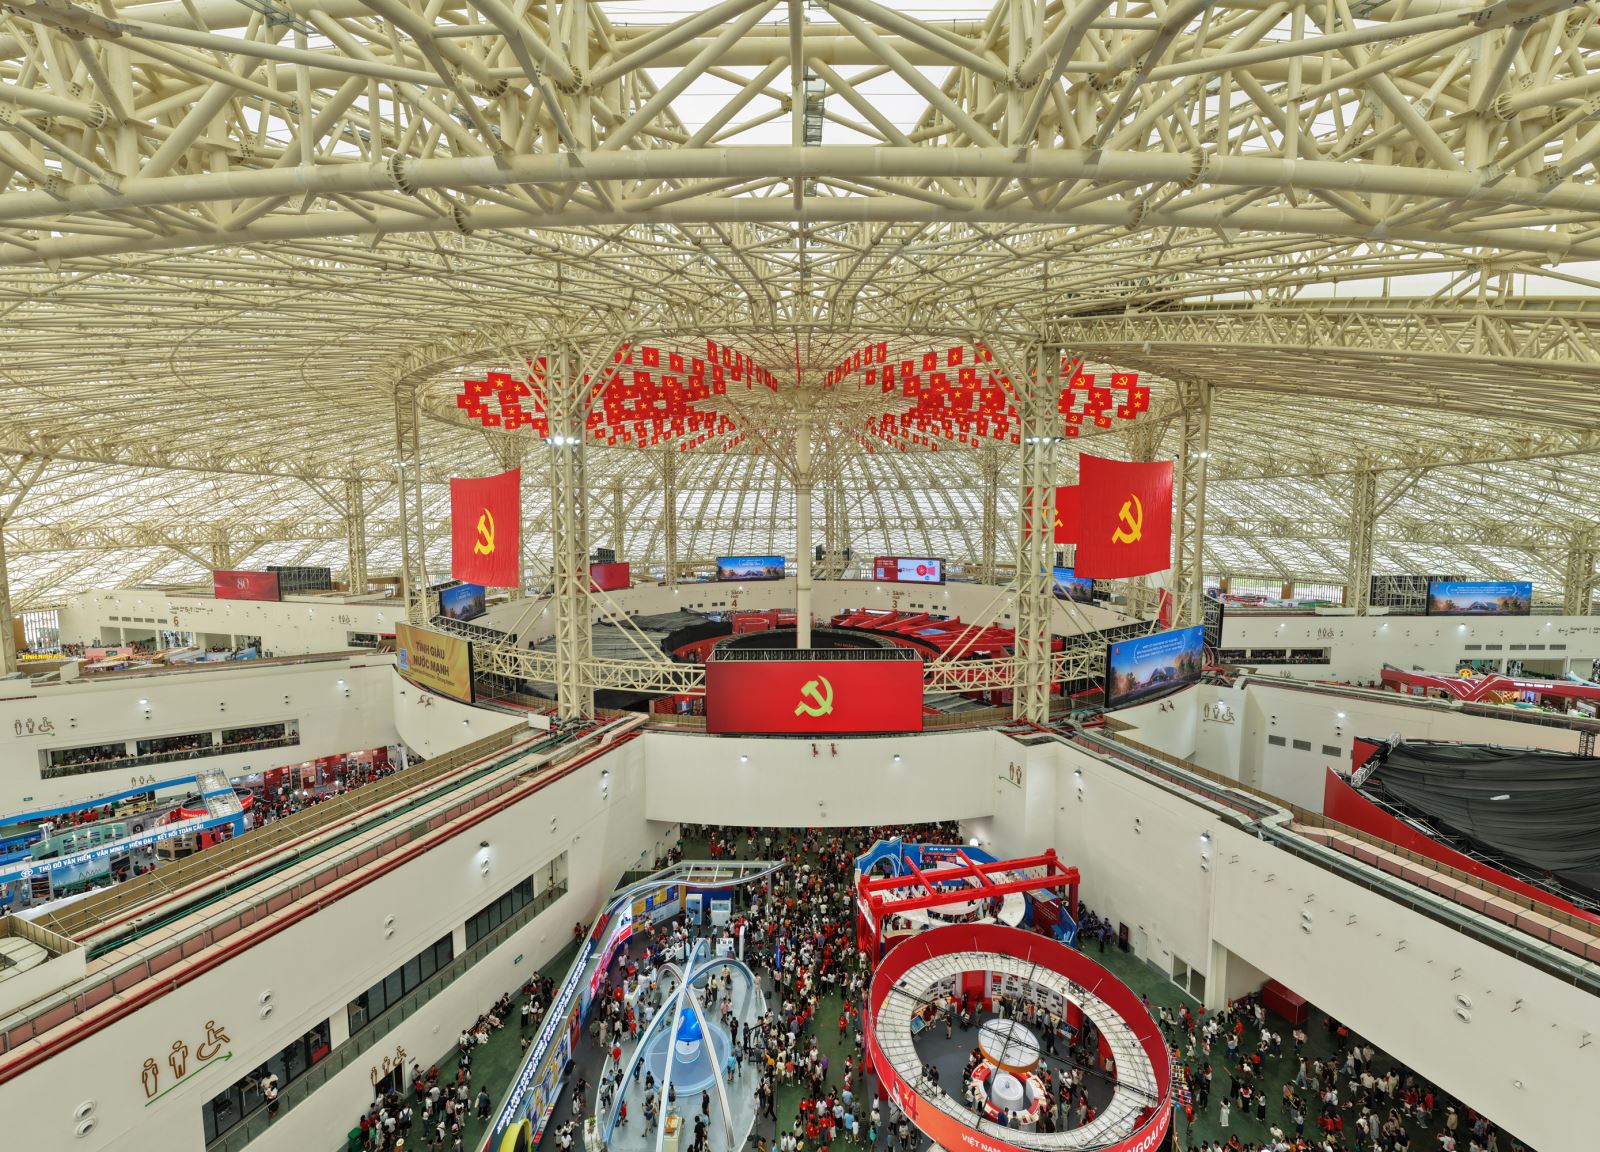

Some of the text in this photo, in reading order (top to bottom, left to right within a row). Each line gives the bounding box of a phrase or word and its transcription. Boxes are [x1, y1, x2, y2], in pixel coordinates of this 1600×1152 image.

[732, 600, 737, 608] 4
[892, 600, 898, 608] 3
[174, 616, 179, 626] 6
[39, 862, 52, 872] THỦ
[53, 860, 62, 869] ĐÔ
[64, 856, 76, 867] VĂN
[77, 852, 92, 863] HIẾN
[96, 848, 109, 858] VĂN
[110, 845, 124, 855] MINH
[129, 839, 142, 850] HIỆN
[158, 832, 168, 841] KẾT
[179, 826, 192, 836] TOÀN
[193, 823, 204, 832] CẦU
[962, 1133, 980, 1148] VIỆT
